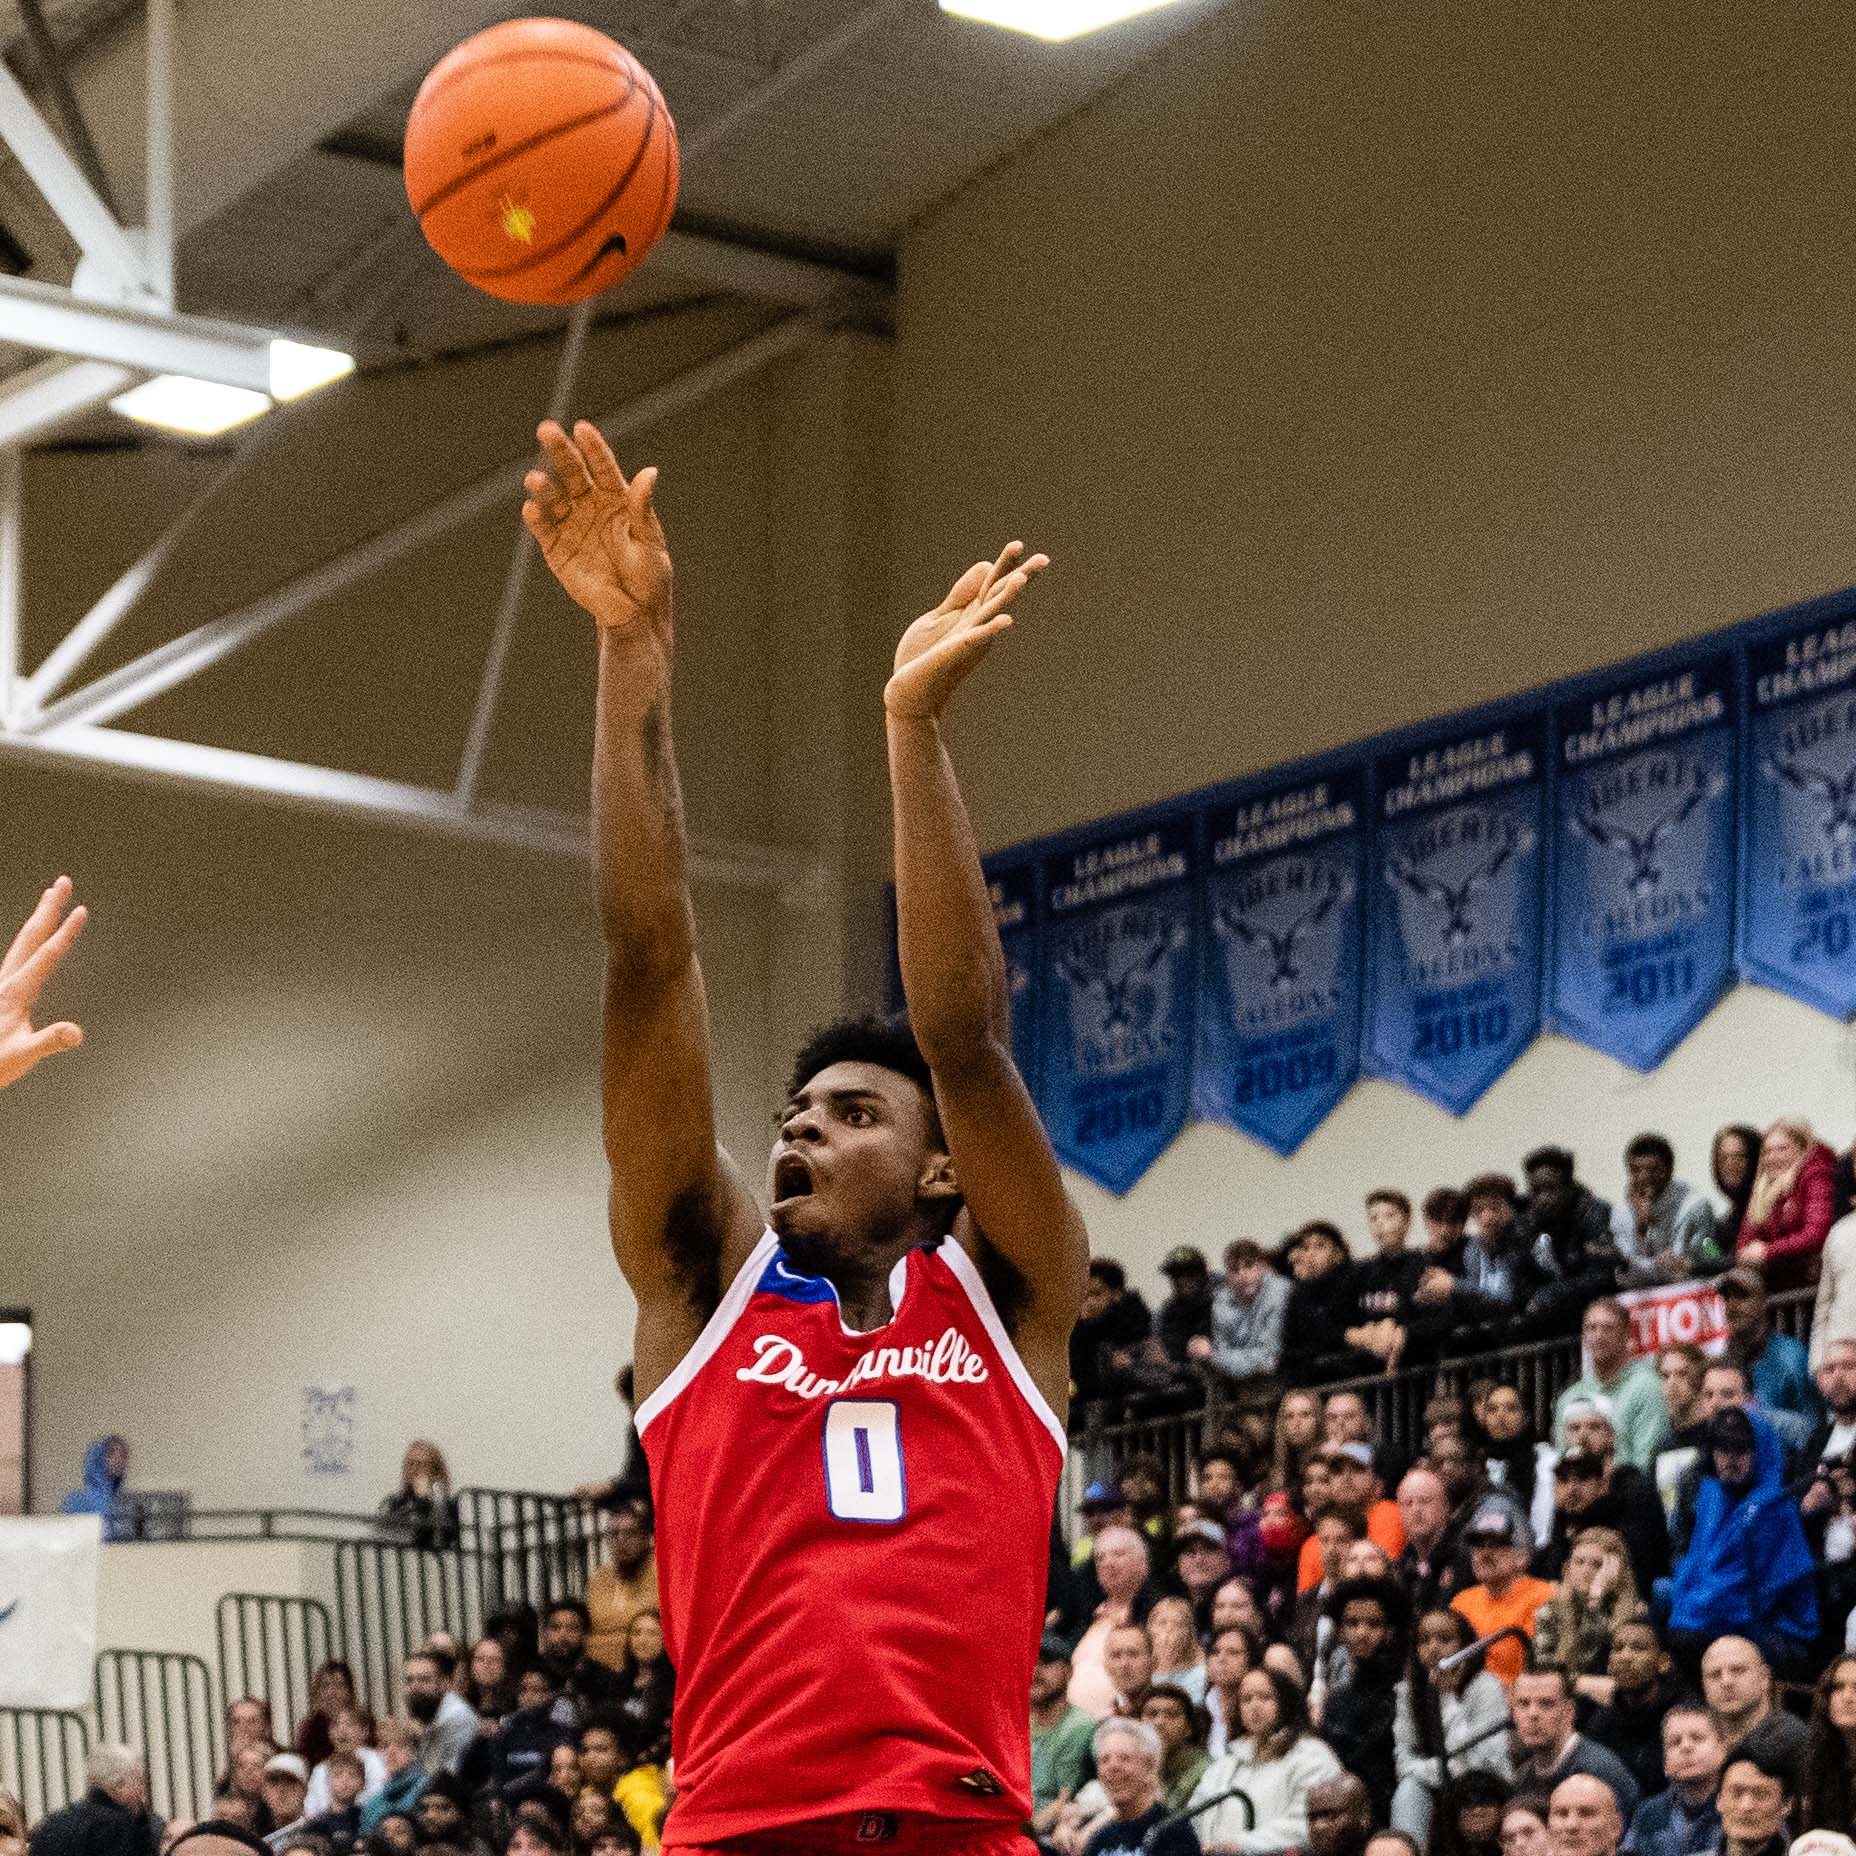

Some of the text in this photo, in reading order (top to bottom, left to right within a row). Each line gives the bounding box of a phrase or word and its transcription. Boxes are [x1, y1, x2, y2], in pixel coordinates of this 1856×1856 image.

[1564, 694, 1725, 762] CHAMPIONS
[1591, 673, 1694, 730] LEAGUE
[1384, 750, 1535, 816] CHAMPIONS
[1213, 803, 1356, 867] CHAMPIONS
[1051, 852, 1188, 911] CHAMPIONS
[822, 1397, 907, 1524] 0
